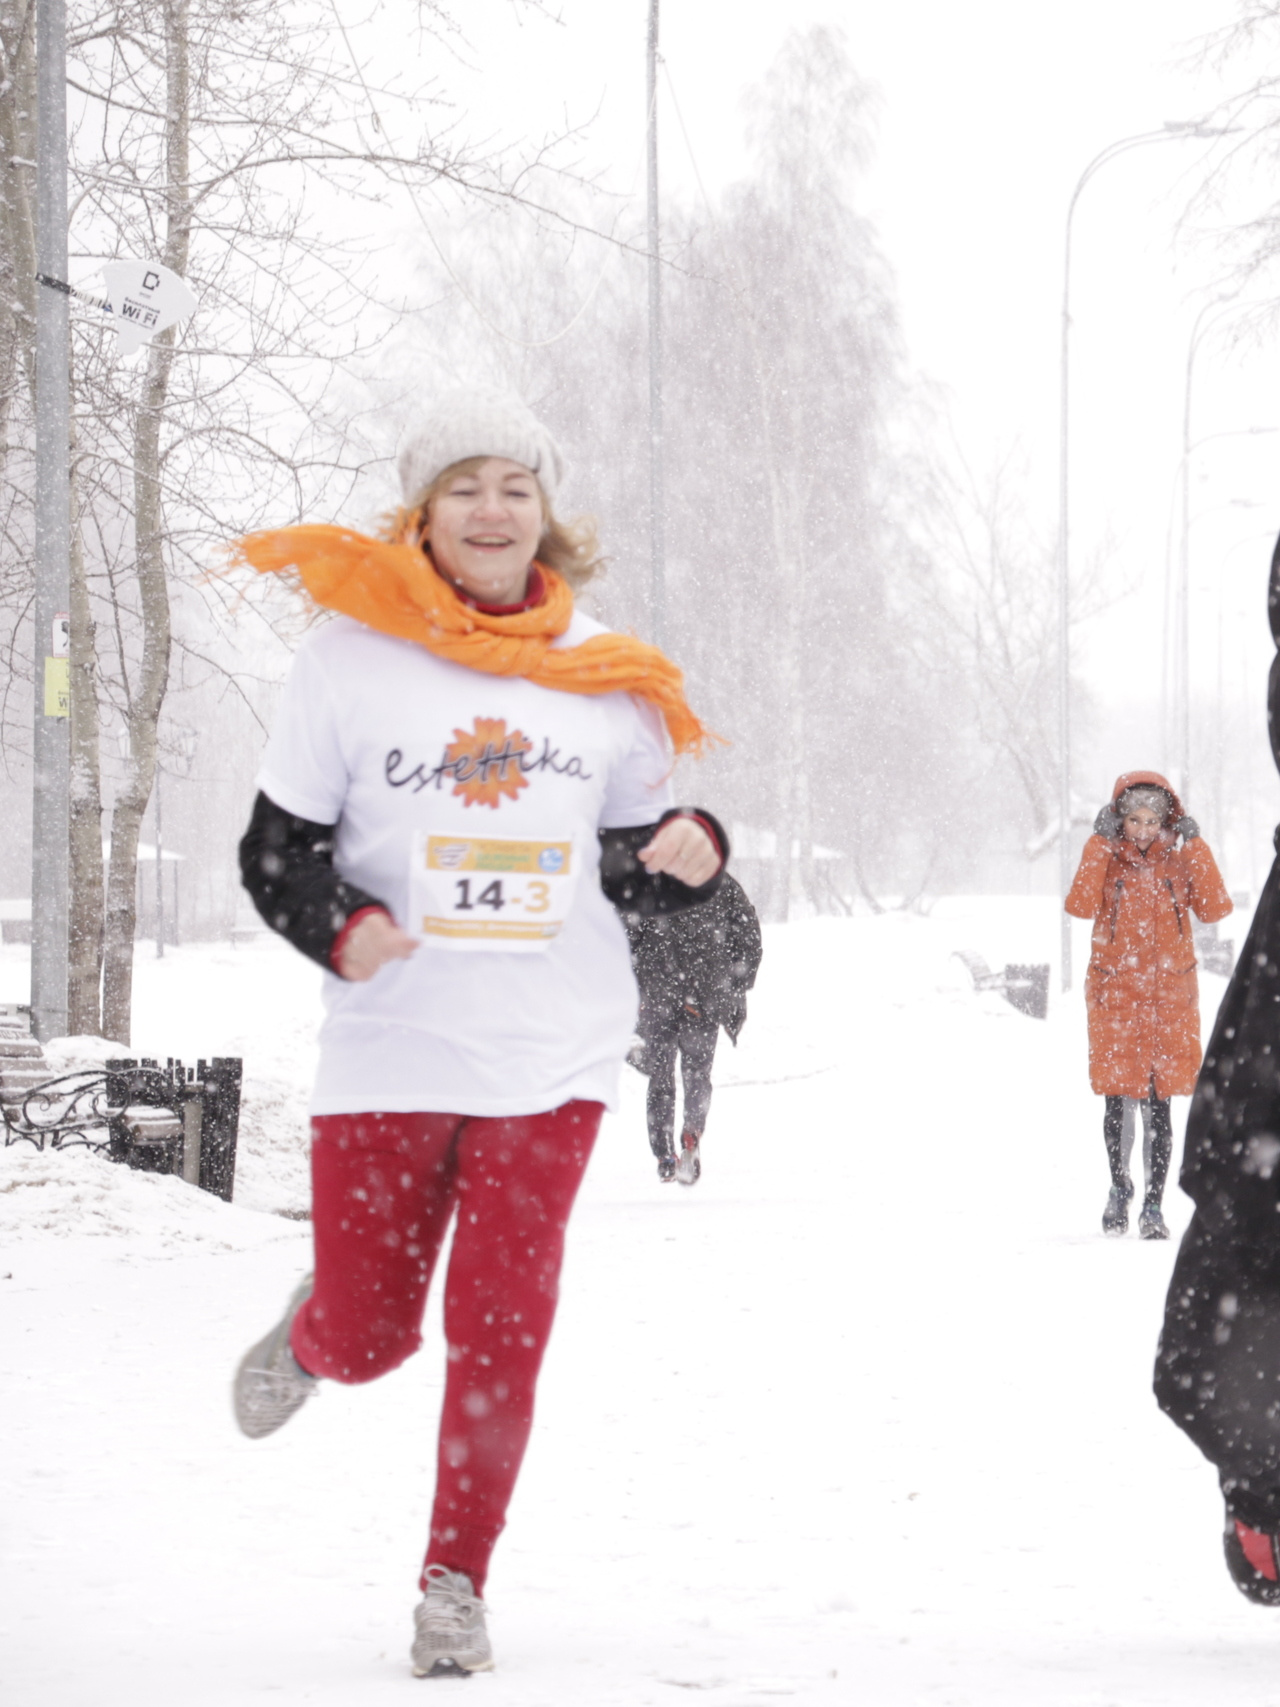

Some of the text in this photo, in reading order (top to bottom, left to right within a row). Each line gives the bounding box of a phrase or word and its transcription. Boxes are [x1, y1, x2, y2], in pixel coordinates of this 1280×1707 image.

[122, 303, 142, 319] Wi
[143, 312, 158, 326] Fi
[454, 879, 551, 912] 14-3
